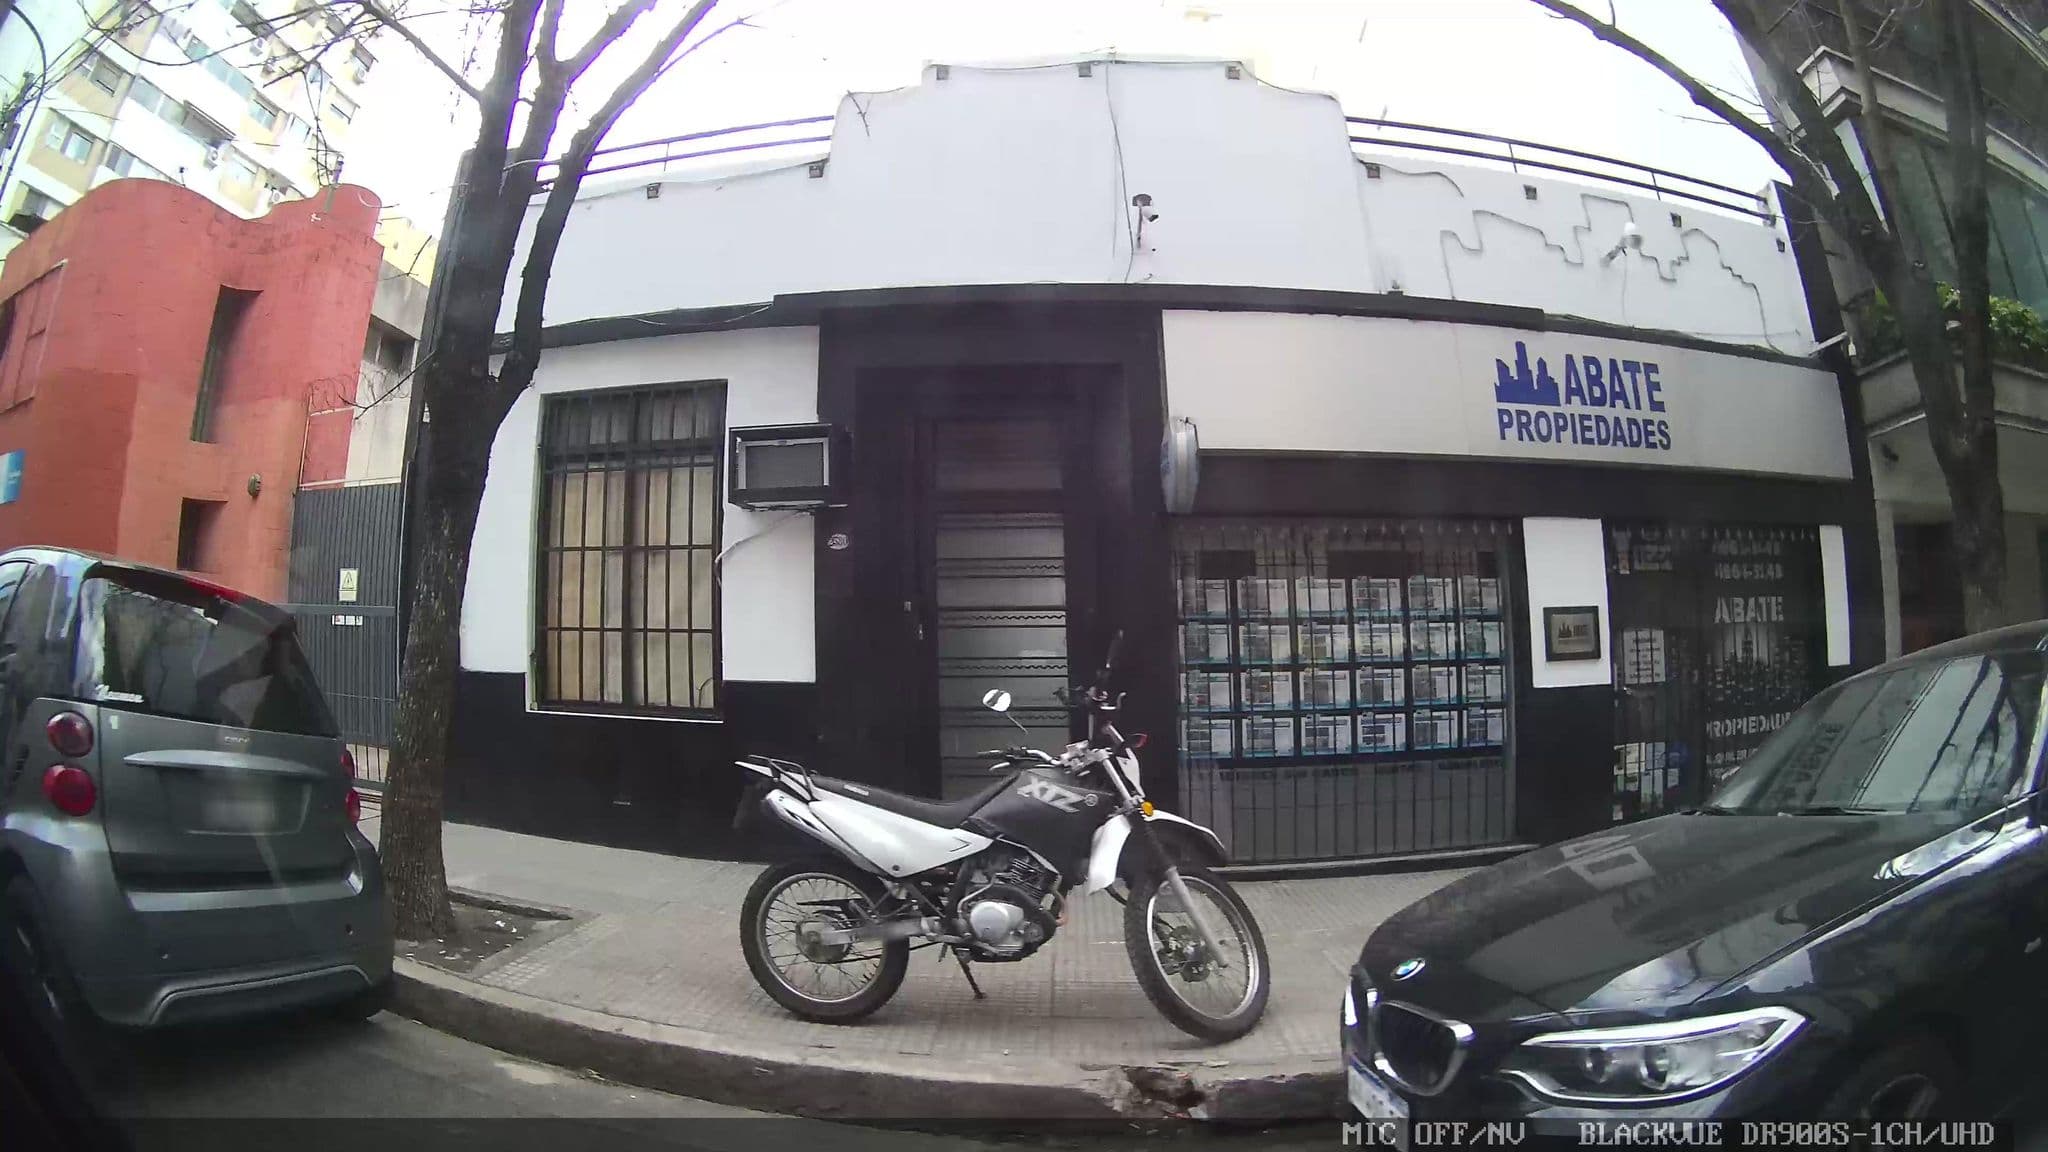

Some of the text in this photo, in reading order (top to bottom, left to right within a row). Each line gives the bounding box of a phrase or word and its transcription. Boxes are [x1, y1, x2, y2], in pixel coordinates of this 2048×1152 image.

[1564, 353, 1666, 413] ABATE
[1497, 408, 1671, 450] PROPIEDADES
[1714, 596, 1784, 623] ABATE
[1017, 775, 1081, 813] XTZ
